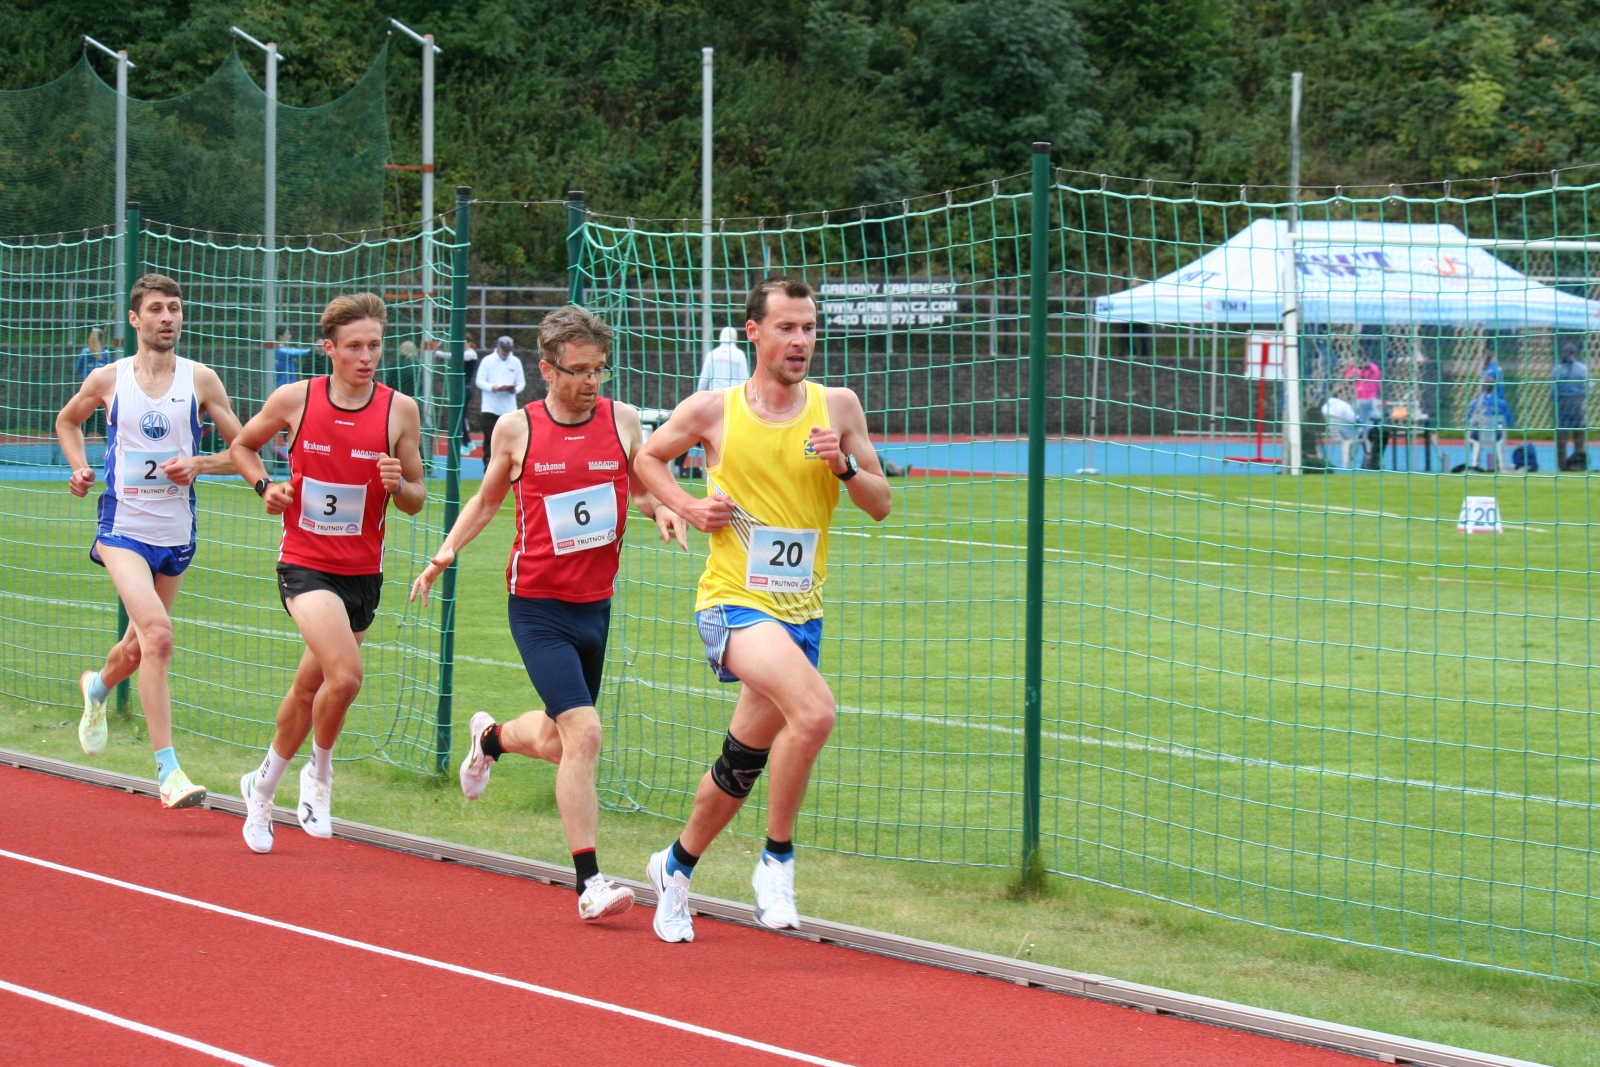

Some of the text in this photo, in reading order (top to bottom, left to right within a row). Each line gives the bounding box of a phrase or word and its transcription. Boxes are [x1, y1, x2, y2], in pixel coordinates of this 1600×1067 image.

[820, 284, 879, 295] GABIONY
[144, 459, 157, 480] 2
[323, 494, 338, 516] 3
[574, 500, 591, 526] 6
[577, 535, 606, 546] TRUTNOV
[769, 539, 803, 568] 20
[771, 580, 799, 588] TRUTNOV
